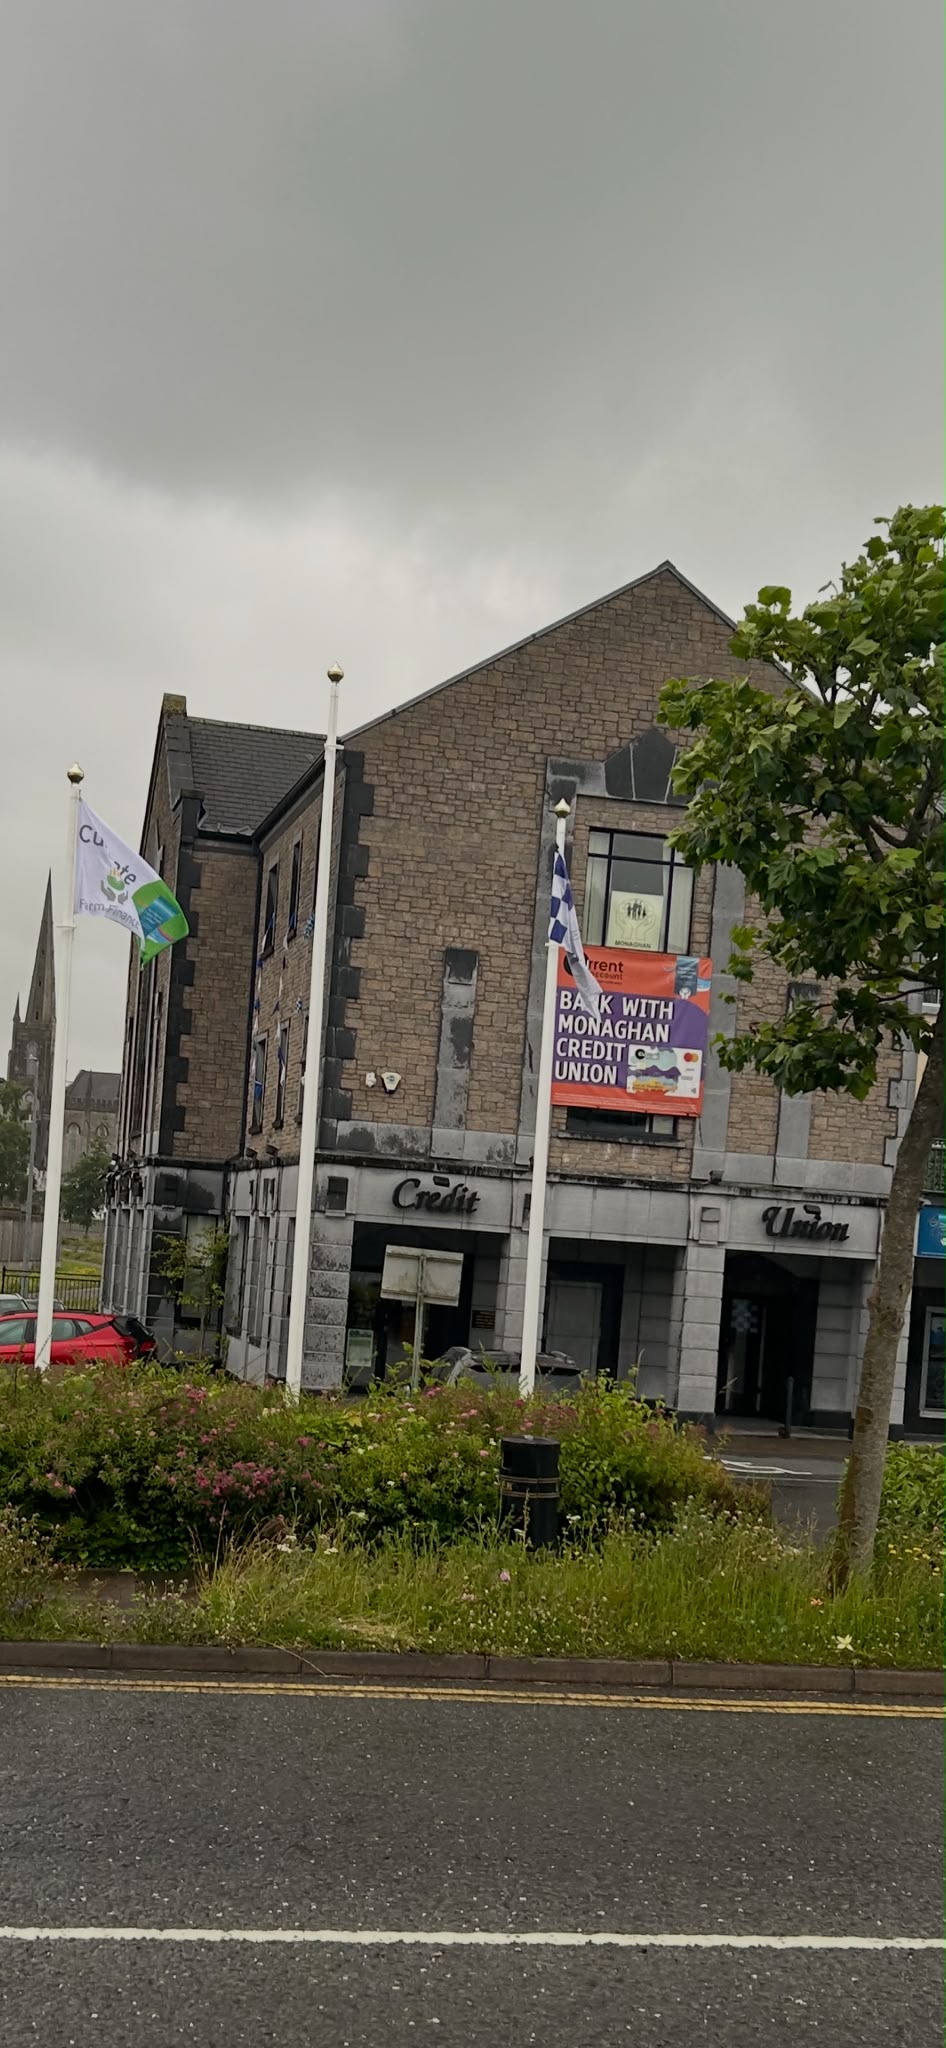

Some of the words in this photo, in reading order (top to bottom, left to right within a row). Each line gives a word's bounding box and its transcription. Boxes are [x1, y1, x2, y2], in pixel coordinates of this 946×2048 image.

[559, 990, 614, 1015] BAK
[622, 996, 674, 1020] WITH
[558, 1014, 670, 1043] MONAGHAN
[556, 1037, 627, 1062] CREDIT
[554, 1060, 618, 1085] UNION
[392, 1178, 480, 1214] Credit
[762, 1206, 850, 1241] Union
